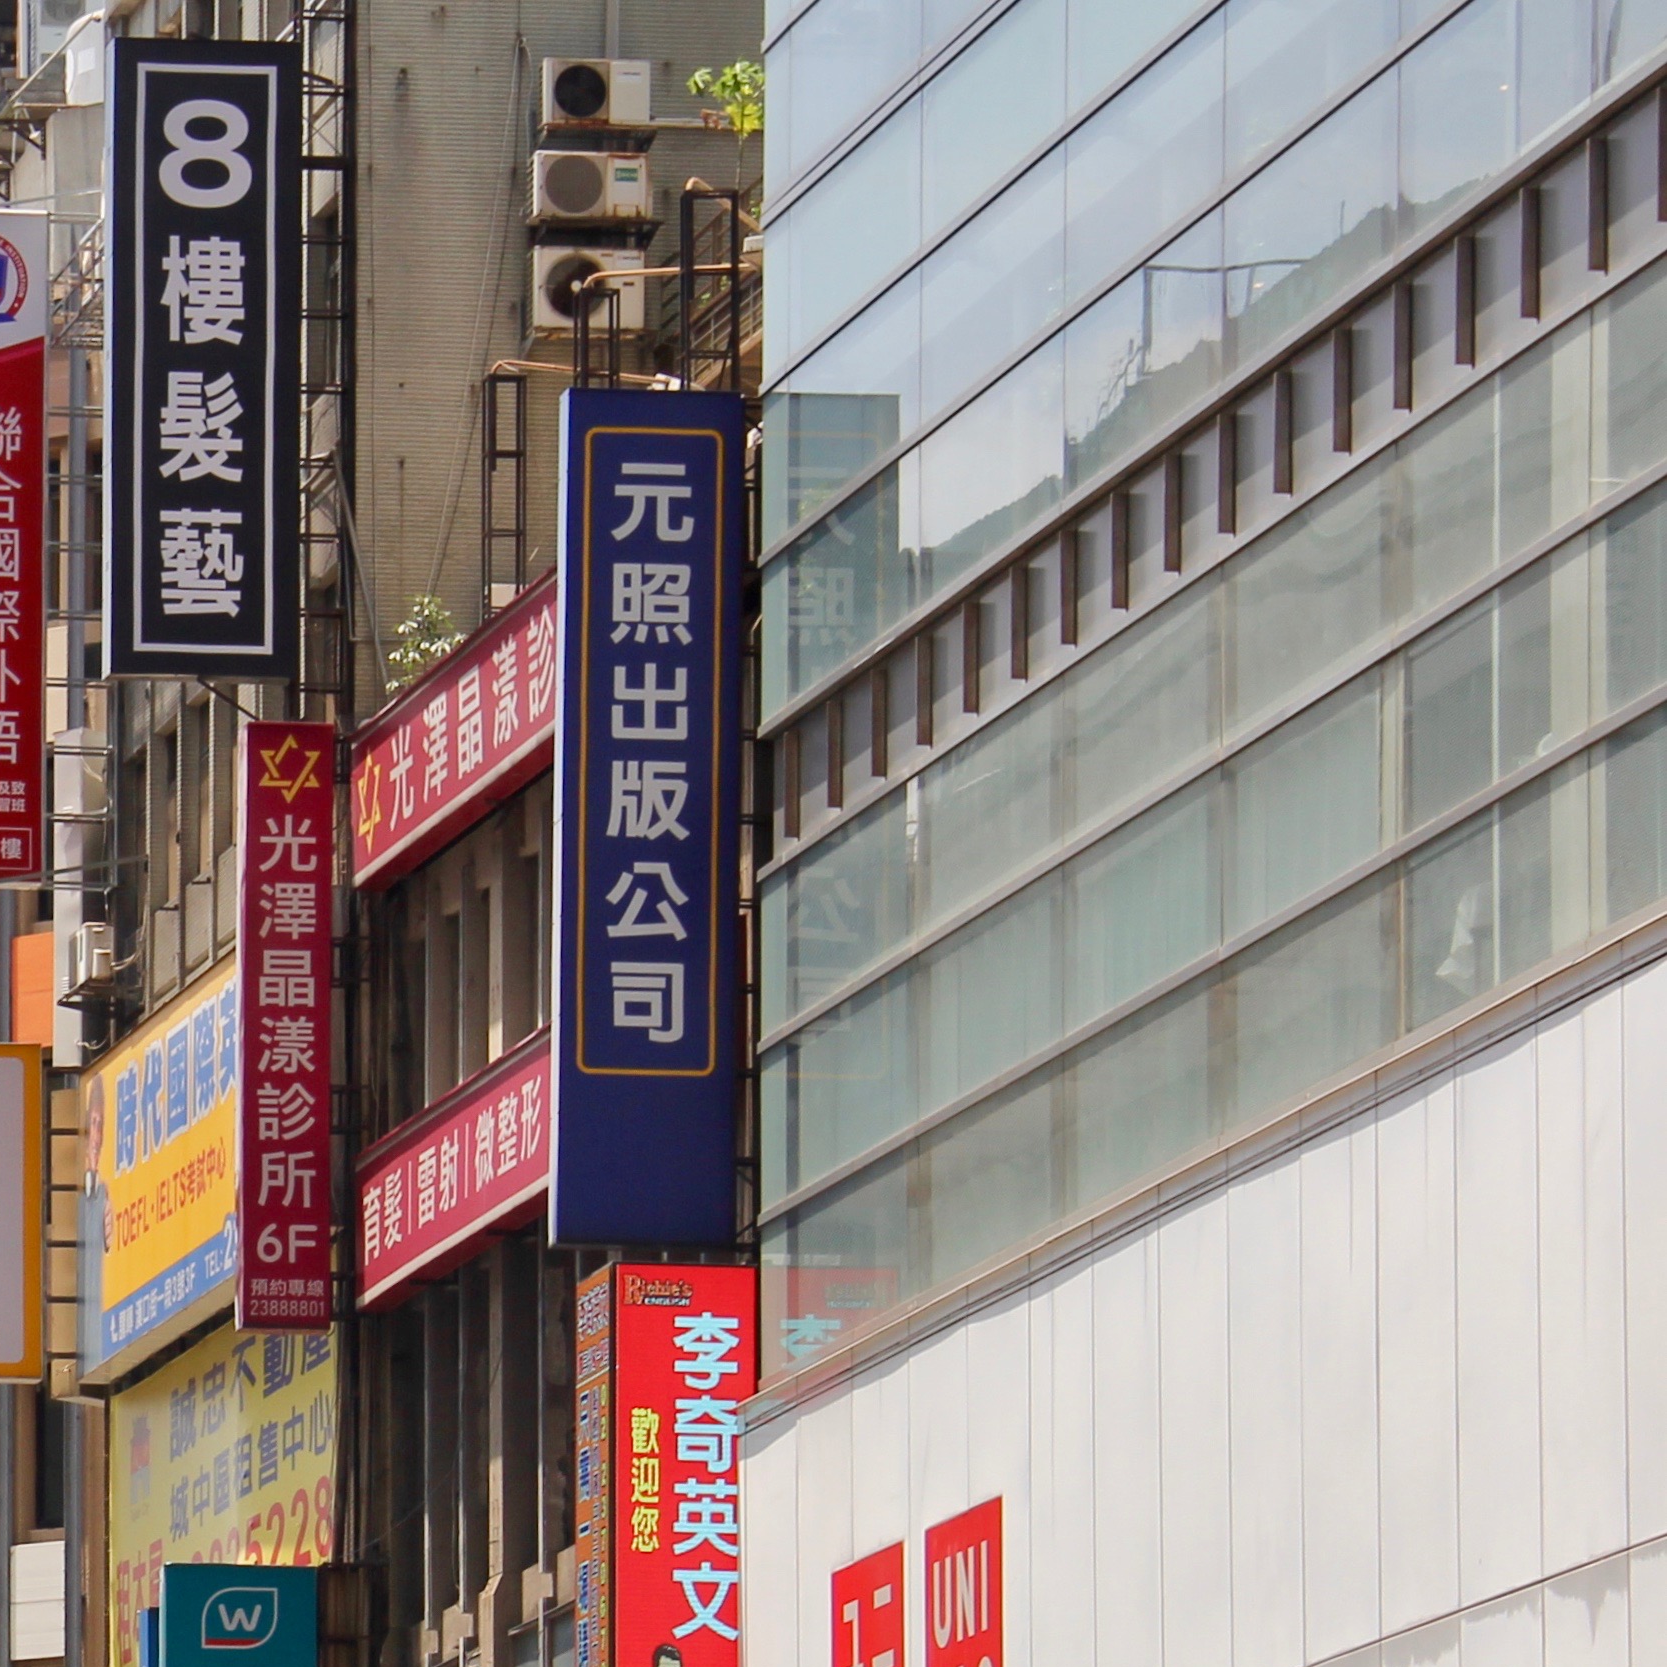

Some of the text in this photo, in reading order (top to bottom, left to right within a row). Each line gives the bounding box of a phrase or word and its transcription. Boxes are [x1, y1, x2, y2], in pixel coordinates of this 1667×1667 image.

[158, 98, 253, 619] 8樓髮藝
[605, 462, 695, 1044] 元照出版公司
[257, 815, 318, 1212] 光澤晶漾診所
[417, 1132, 459, 1229] 雷射
[474, 1074, 542, 1199] 微整形
[250, 1299, 325, 1318] 23888801
[251, 1278, 325, 1297] 預約專線
[256, 1224, 317, 1264] 6F
[630, 1407, 660, 1554] 歡迎您
[671, 1311, 740, 1643] 李奇英文
[218, 1603, 262, 1632] W
[932, 1539, 989, 1649] UNI
